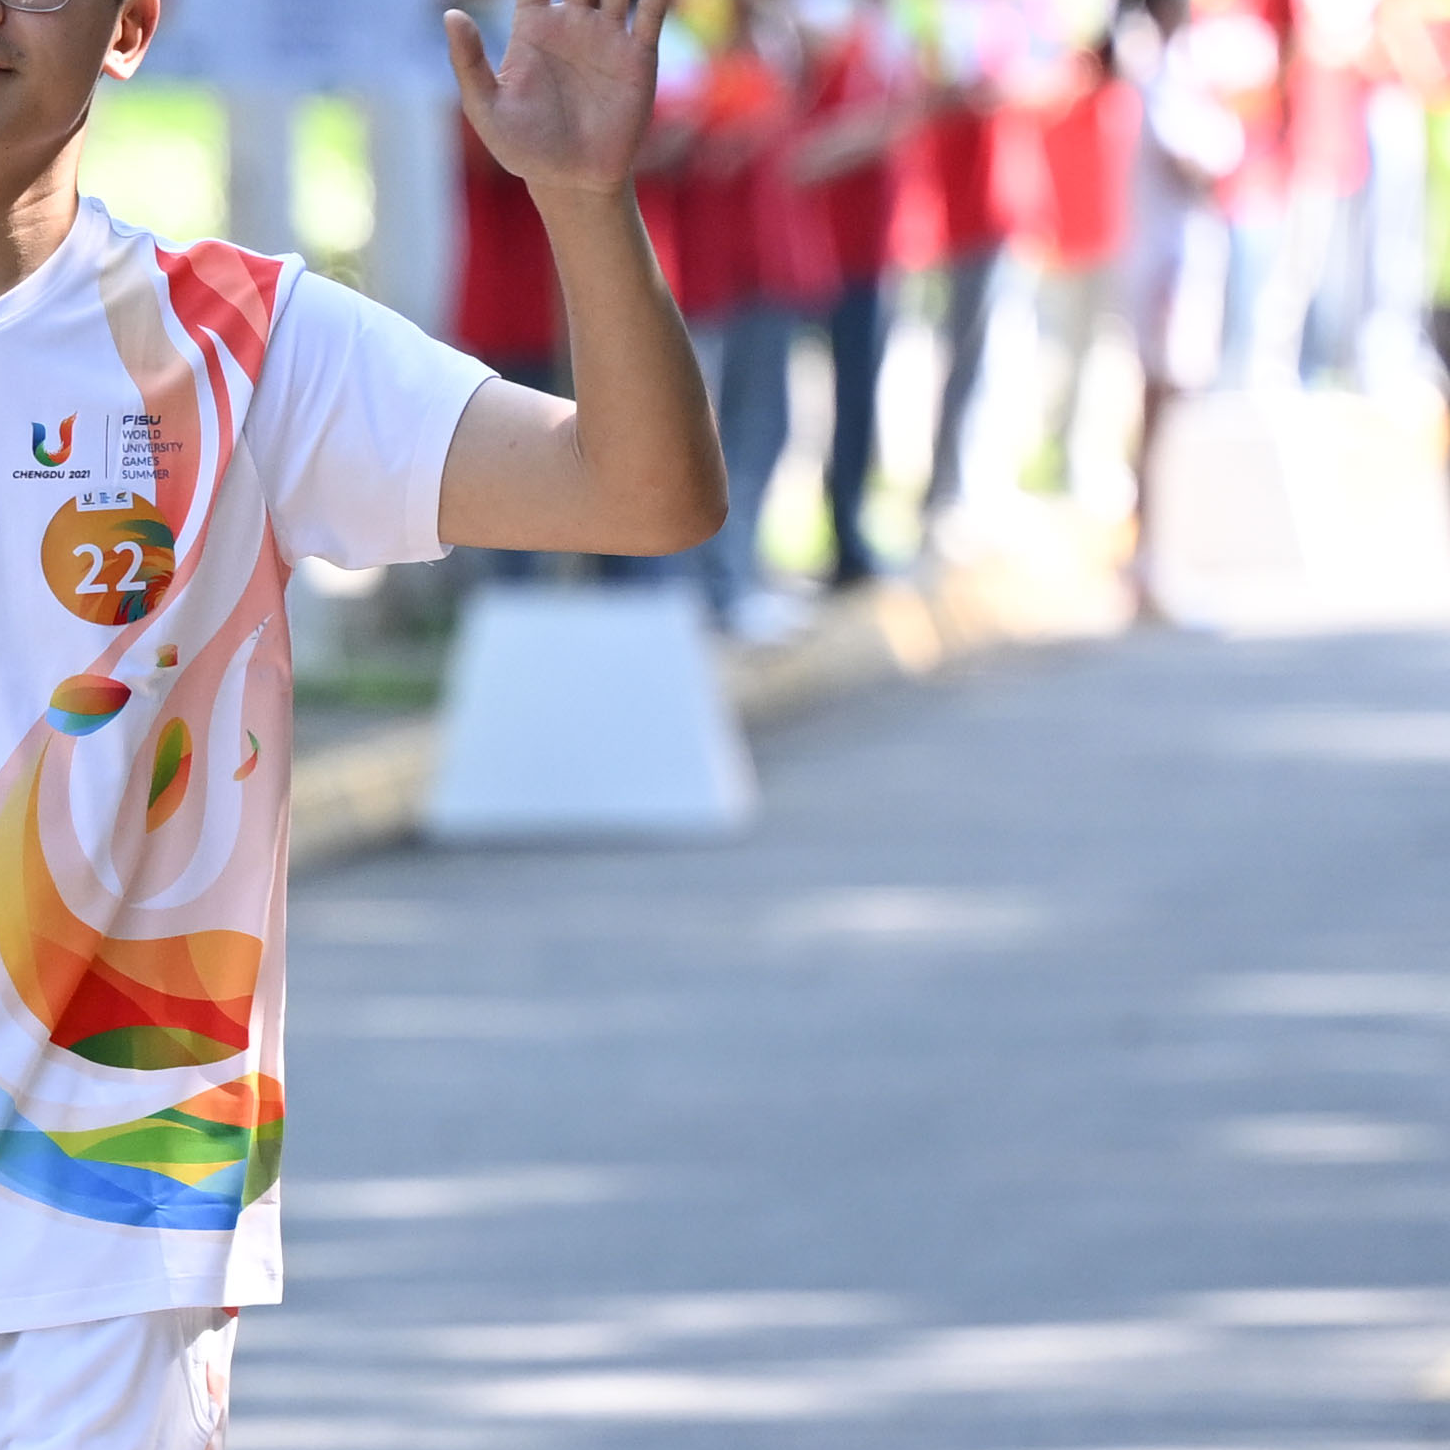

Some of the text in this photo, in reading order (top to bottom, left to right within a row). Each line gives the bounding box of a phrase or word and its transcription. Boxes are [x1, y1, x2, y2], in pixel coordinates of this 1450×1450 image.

[122, 415, 161, 425] FISU
[122, 429, 161, 439] WORLD
[122, 442, 183, 453] UNIVERSITY
[122, 456, 160, 466] GAMES
[12, 469, 90, 479] CHENGDU 2021
[122, 469, 169, 480] SUMMER
[72, 540, 147, 595] 22
